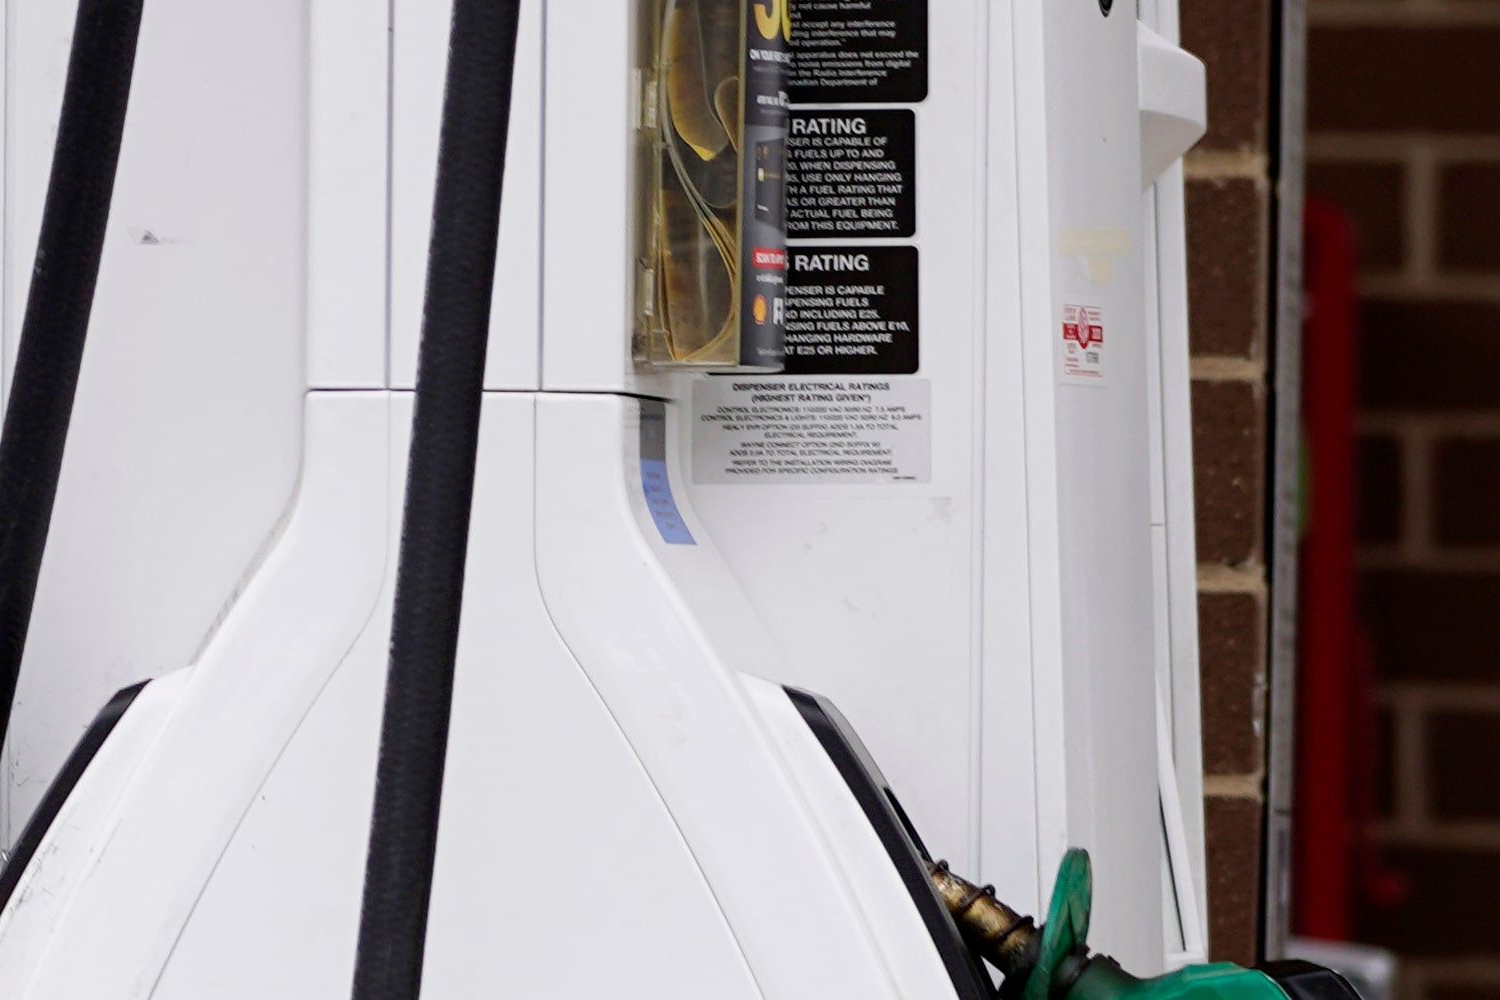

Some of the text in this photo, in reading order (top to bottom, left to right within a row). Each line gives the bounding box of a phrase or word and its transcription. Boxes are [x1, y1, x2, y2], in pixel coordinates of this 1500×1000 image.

[838, 2, 871, 10] harmful
[846, 20, 896, 28] interference
[796, 51, 837, 59] apparatus
[905, 50, 919, 58] the
[885, 60, 911, 69] digital
[820, 78, 868, 87] Department
[792, 118, 867, 135] RATING
[812, 137, 823, 147] IS
[824, 137, 871, 147] CAPABLE
[872, 136, 888, 147] OF
[794, 148, 885, 159] FUELS UP TO AND
[800, 161, 832, 171] WHEN
[833, 160, 896, 170] DISPENSING
[801, 173, 822, 182] USE
[824, 173, 852, 182] ONLY
[853, 172, 902, 182] HANGING
[799, 185, 808, 194] A
[809, 185, 836, 194] FUEL
[837, 185, 876, 194] RATING
[877, 184, 903, 194] THAT
[800, 197, 816, 206] OR
[818, 197, 866, 206] GREATER
[867, 197, 896, 206] THAN
[790, 208, 894, 219] ACTUAL FUEL BEING
[811, 221, 835, 230] THIS
[836, 221, 900, 230] EQUIPMENT.
[794, 254, 869, 271] RATING
[825, 286, 836, 295] IS
[837, 285, 885, 295] CAPABLE
[836, 297, 870, 307] FUELS
[800, 310, 858, 319] INCLUDING
[817, 321, 850, 331] FUELS
[851, 321, 887, 331] ABOVE
[833, 333, 893, 343] HARDWARE
[817, 346, 834, 355] OR
[732, 382, 890, 391] DISPENSER ELECTRICAL RATINGS
[797, 394, 833, 402] RATING
